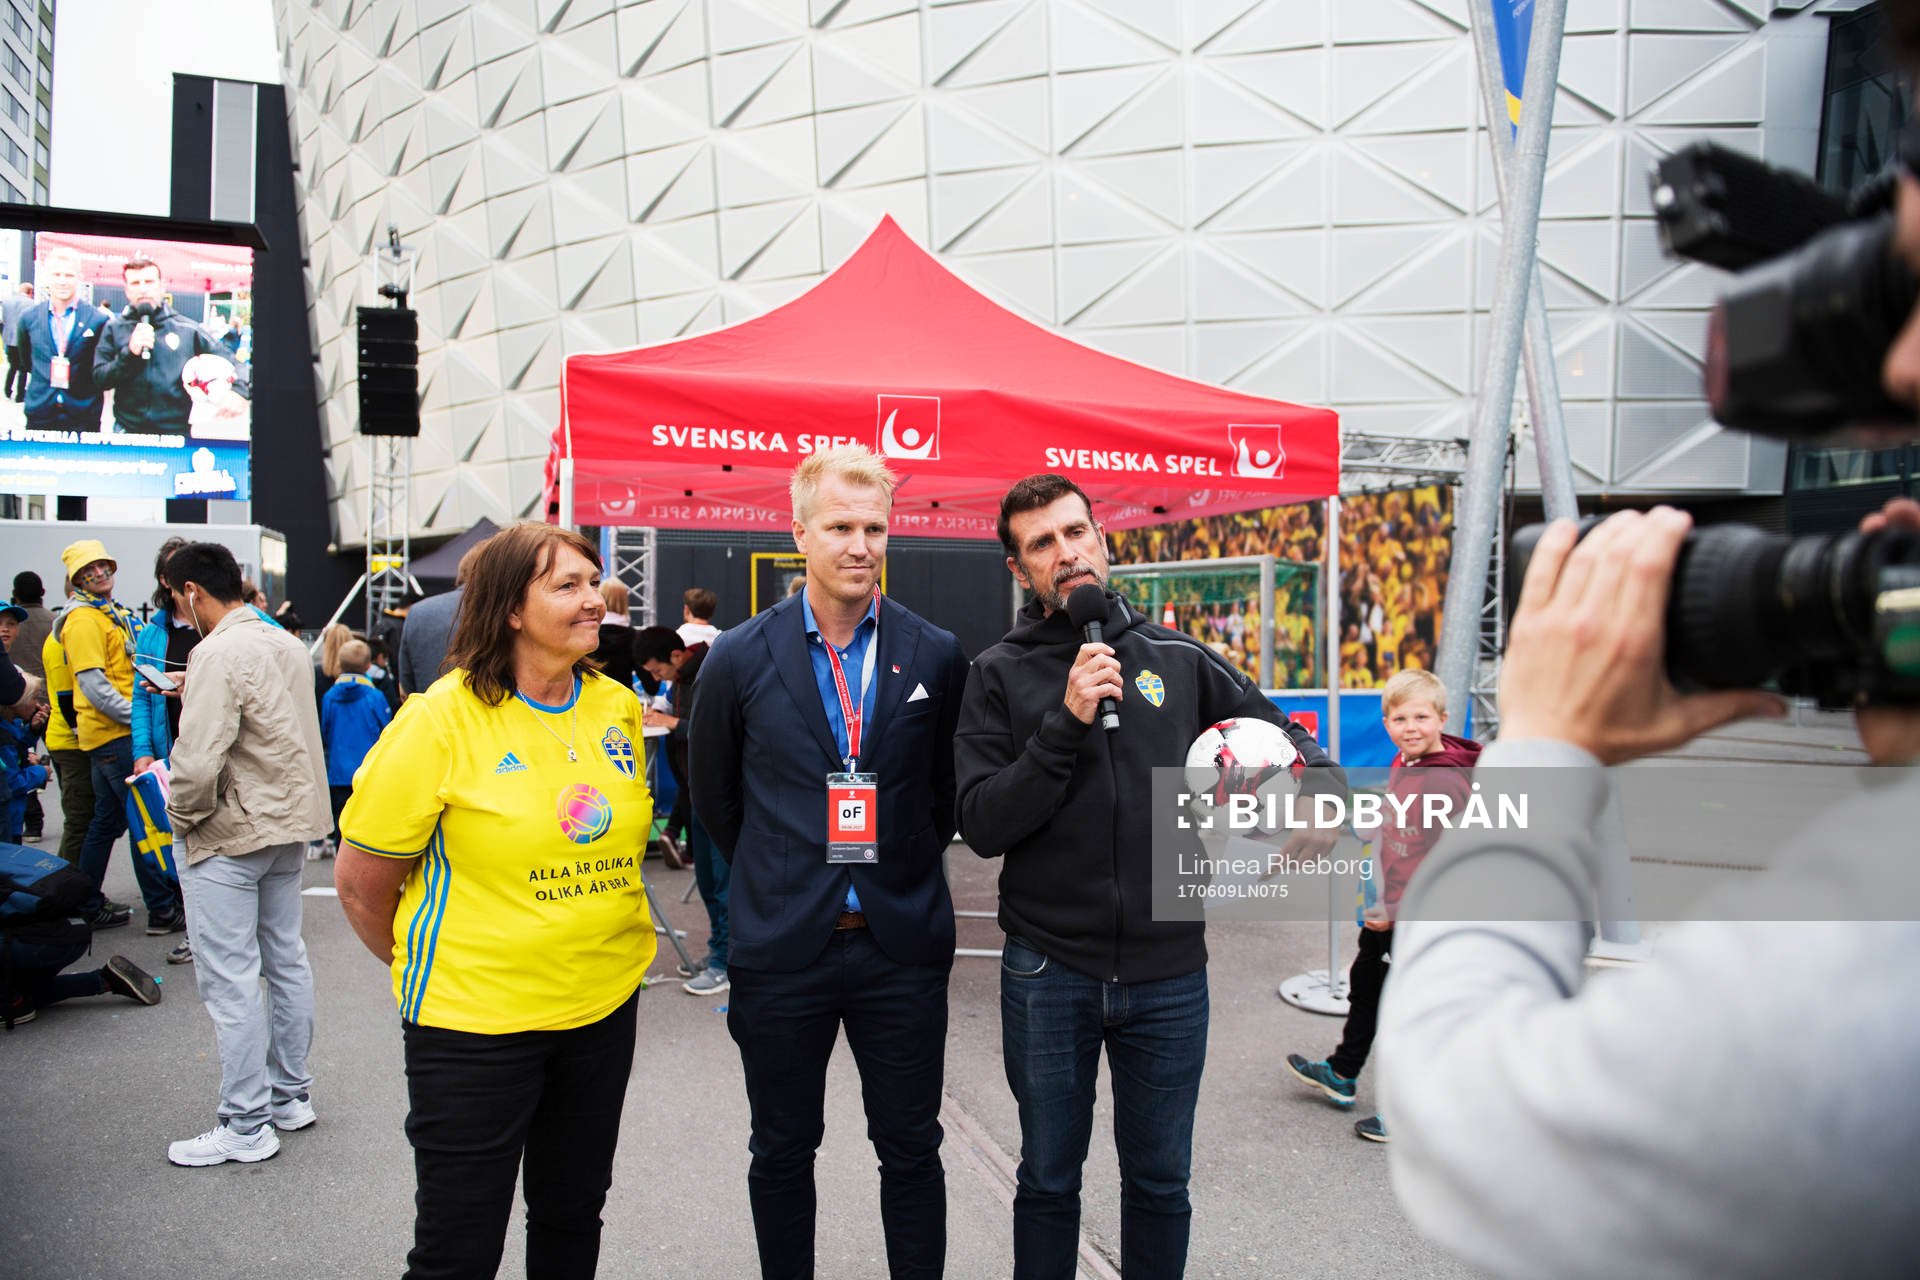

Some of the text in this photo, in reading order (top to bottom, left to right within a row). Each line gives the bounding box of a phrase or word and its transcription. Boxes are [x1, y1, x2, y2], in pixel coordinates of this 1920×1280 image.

[652, 424, 788, 453] SVENSKA
[1045, 447, 1223, 477] SVENSKA SPEL
[529, 857, 633, 882] ALLA ÄR OLIKA
[535, 876, 630, 900] OLIKA ÄR BRA
